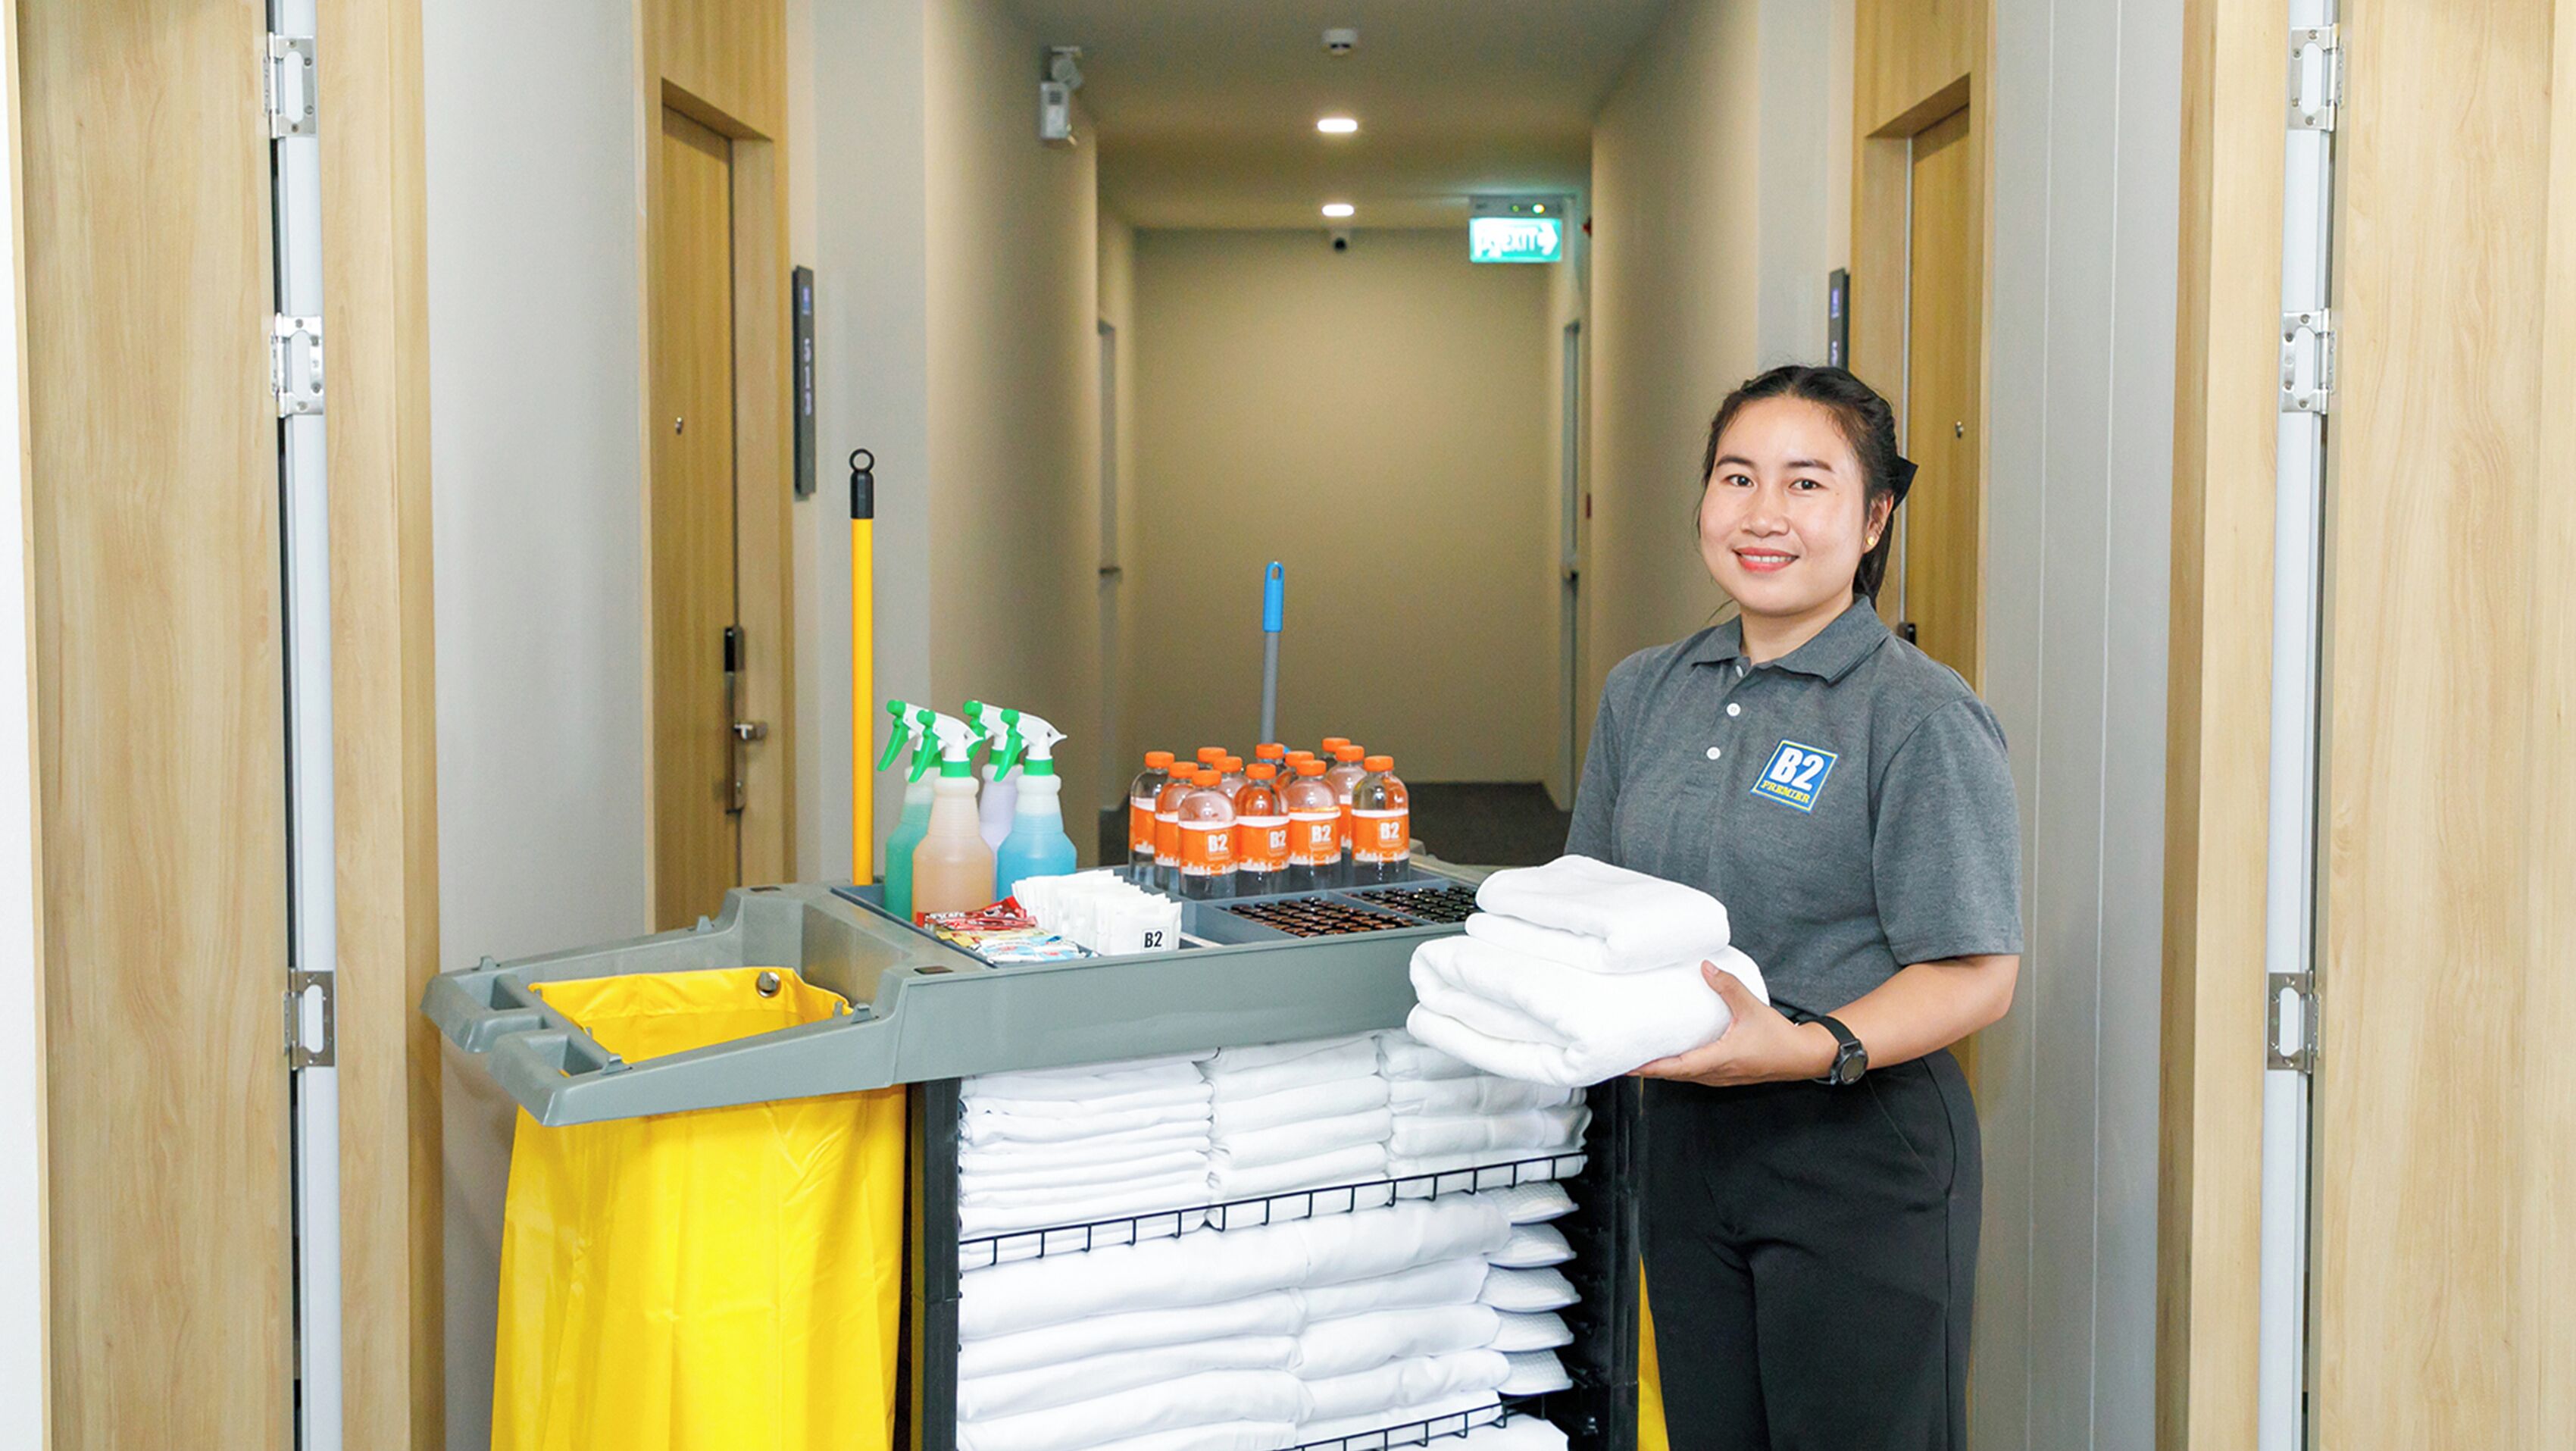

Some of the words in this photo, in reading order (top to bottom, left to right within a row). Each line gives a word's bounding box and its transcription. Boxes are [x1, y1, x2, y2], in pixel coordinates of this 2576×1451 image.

[1502, 227, 1538, 252] EXIT
[1769, 747, 1824, 791] B2
[1760, 780, 1811, 803] PREMIER
[1270, 830, 1286, 849] B2
[1311, 824, 1331, 843] B2
[1380, 821, 1399, 840] B2
[1208, 833, 1229, 852] B2
[1144, 931, 1163, 948] B2
